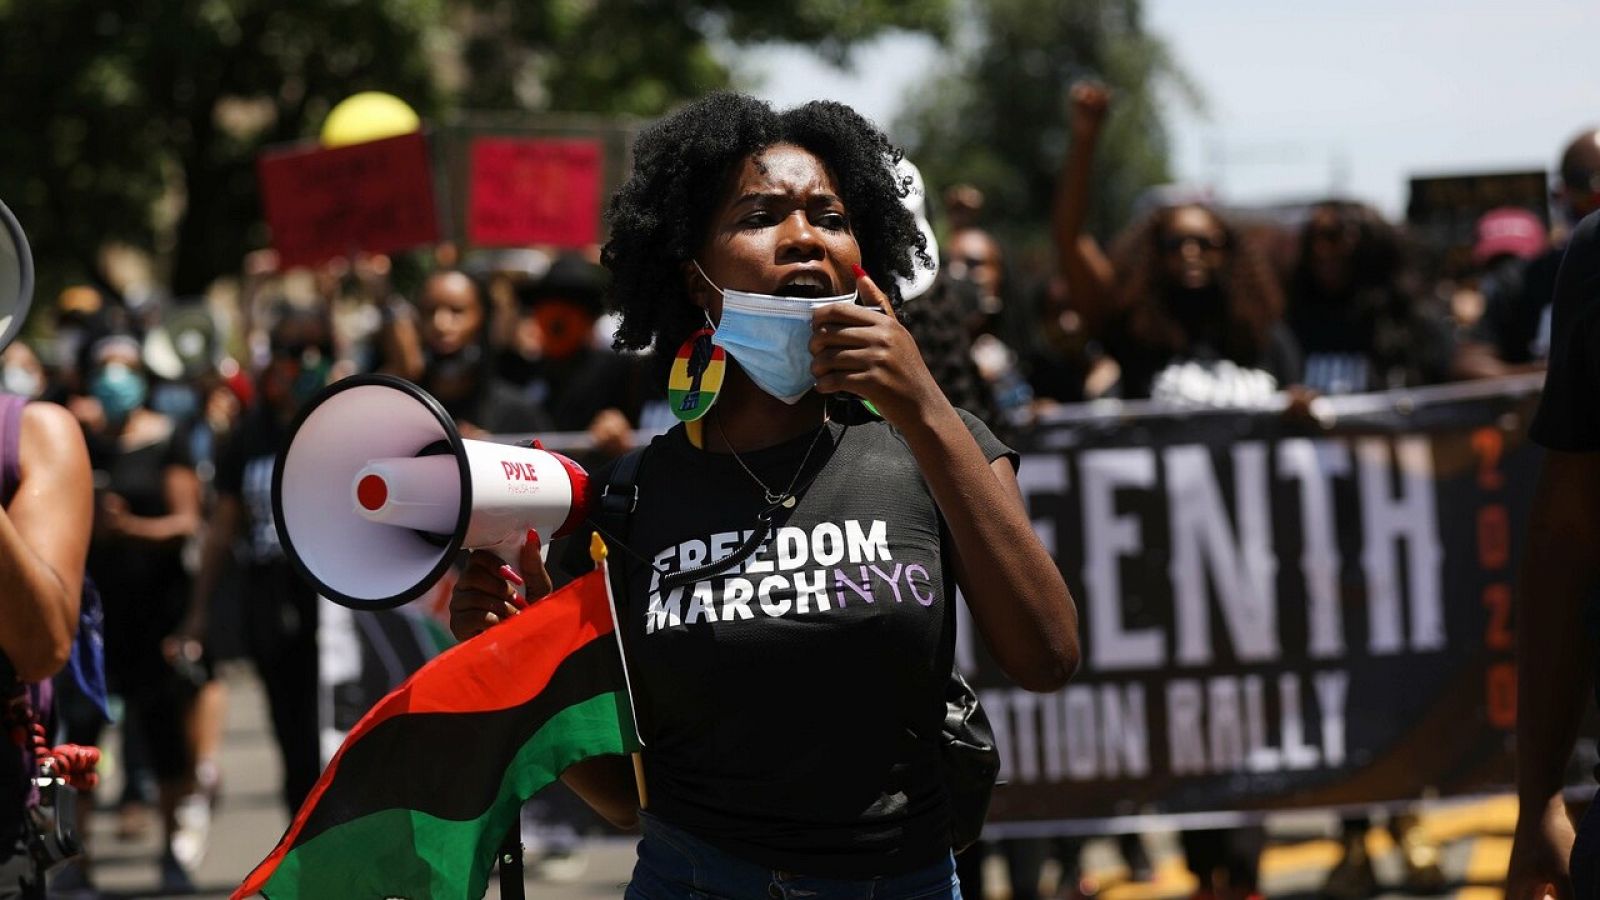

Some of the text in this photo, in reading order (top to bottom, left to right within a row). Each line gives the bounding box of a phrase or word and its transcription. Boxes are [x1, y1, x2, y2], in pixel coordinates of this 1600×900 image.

[500, 461, 538, 481] PYLE
[649, 519, 892, 594] FREEDOM
[1165, 672, 1350, 776] RALLY
